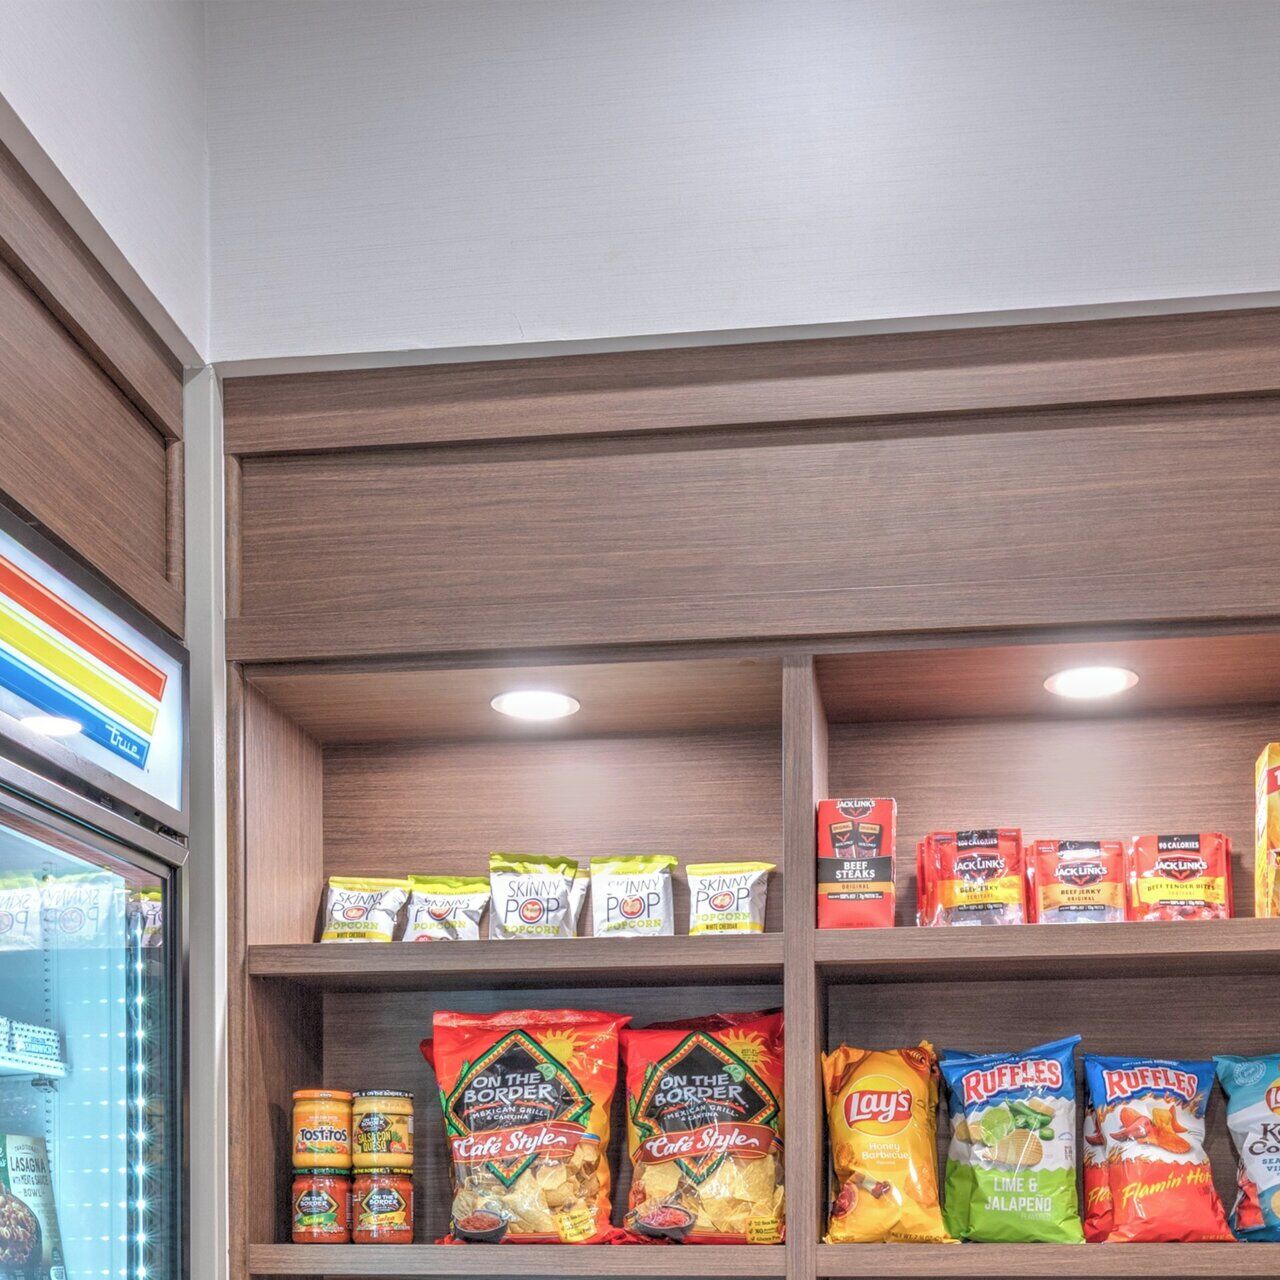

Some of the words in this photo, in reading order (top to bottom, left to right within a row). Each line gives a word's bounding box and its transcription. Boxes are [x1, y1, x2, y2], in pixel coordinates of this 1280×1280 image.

[105, 724, 140, 759] true
[1167, 841, 1200, 849] CALORIES
[843, 861, 868, 870] BEEF
[953, 860, 977, 872] JACK
[1054, 866, 1078, 876] JACK
[1155, 861, 1178, 870] JACK
[835, 869, 876, 879] STEAKS
[508, 877, 561, 898] SKINNY
[699, 875, 753, 892] SKINNY
[606, 892, 661, 922] POP
[695, 886, 751, 914] POP
[504, 897, 561, 924] POP
[327, 922, 378, 930] POPCORN
[504, 924, 561, 935] POPCORN
[607, 919, 663, 932] POPCORN
[472, 1075, 501, 1088] ON
[506, 1072, 541, 1085] THE
[660, 1075, 687, 1090] ON
[691, 1073, 730, 1086] THE
[963, 1059, 1063, 1106] RUFFLES
[1106, 1068, 1198, 1100] RUFFLES
[464, 1084, 556, 1104] BORDER
[654, 1085, 745, 1107] BORDER
[472, 1106, 516, 1119] MEXICAN
[520, 1104, 545, 1117] GRILL
[665, 1105, 706, 1120] MEXICAN
[709, 1105, 736, 1117] GRILL
[850, 1090, 911, 1123] Lay's
[492, 1112, 529, 1120] CANTINA
[453, 1135, 502, 1157] Café
[505, 1127, 568, 1155] Style
[645, 1135, 695, 1158] Café
[696, 1127, 760, 1153] Style
[868, 1142, 900, 1152] Honey
[861, 1151, 909, 1160] Barbecue
[1261, 1157, 1280, 1166] SEA
[10, 1156, 47, 1173] LASAGNA
[993, 1177, 1024, 1193] LIME
[1028, 1177, 1038, 1193] &
[1121, 1170, 1183, 1210] Flamin'
[984, 1194, 1052, 1213] JALAPEÑO
